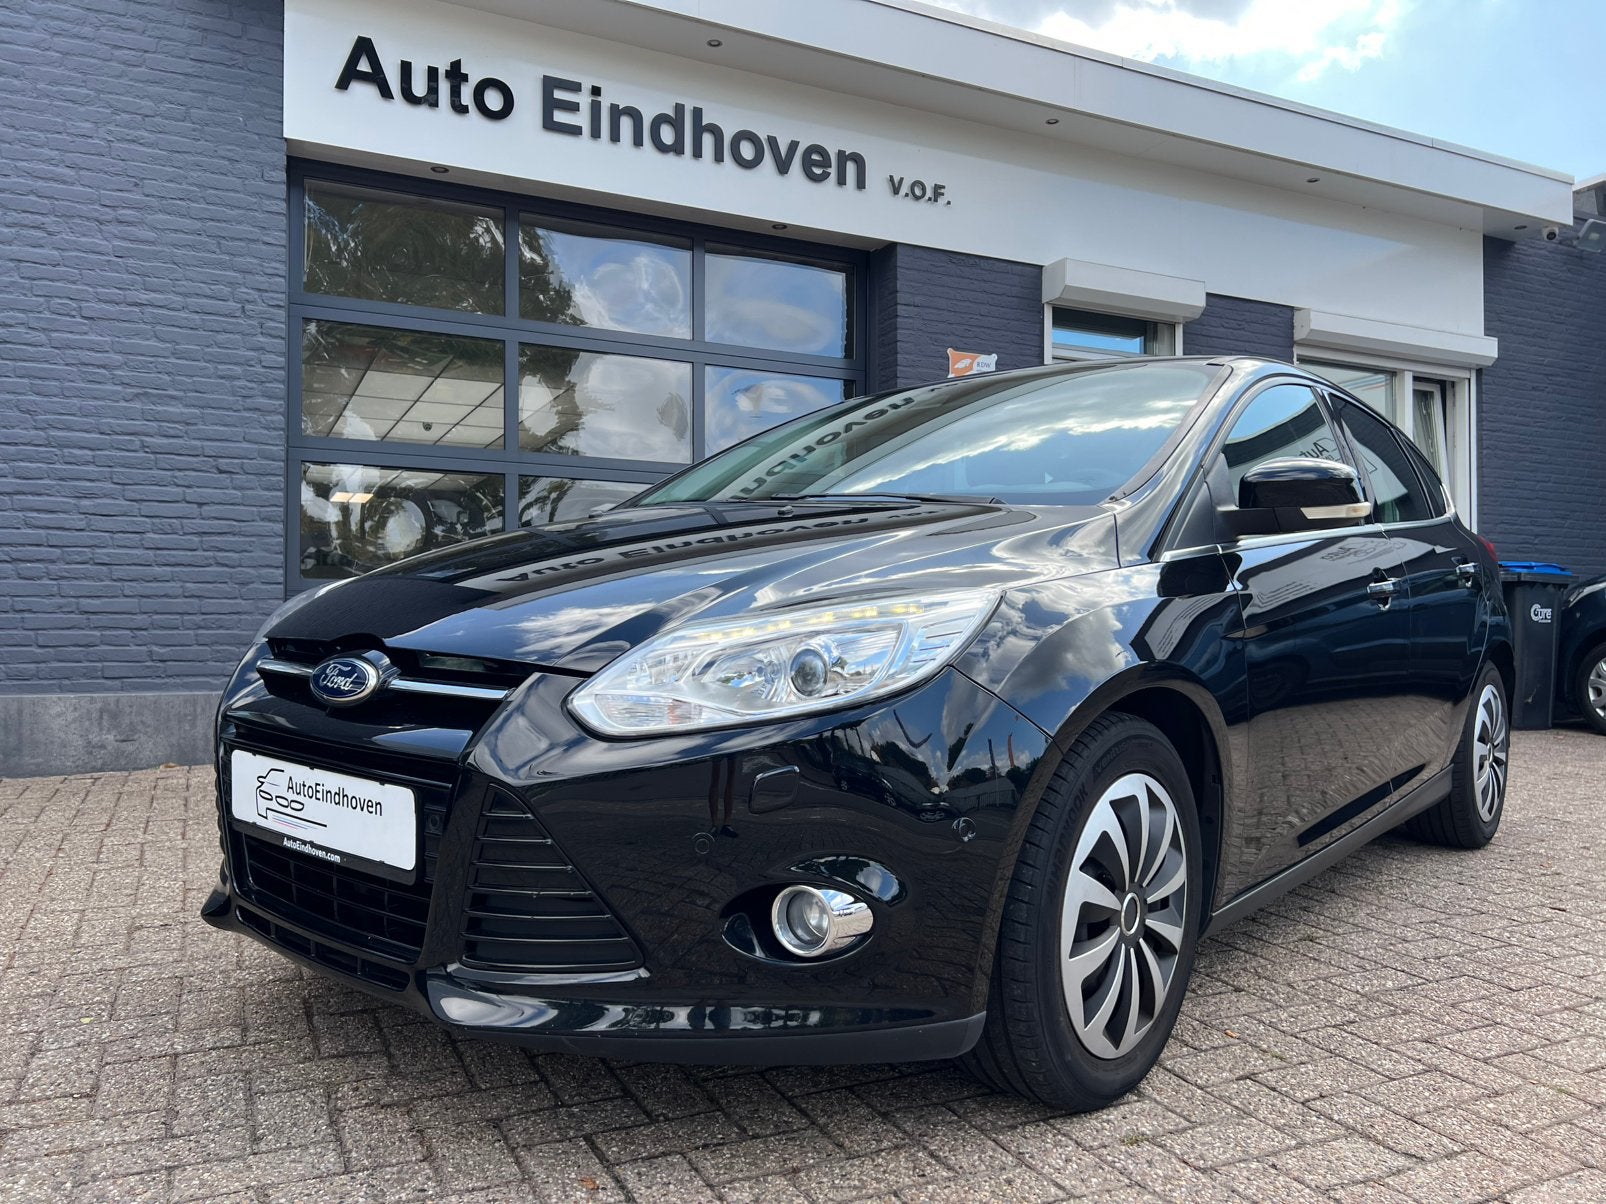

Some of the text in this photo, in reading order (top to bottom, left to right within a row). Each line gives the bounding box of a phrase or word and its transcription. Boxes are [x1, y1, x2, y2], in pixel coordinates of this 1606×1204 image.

[335, 36, 514, 120] Auto
[542, 74, 866, 190] Eindhoven
[1530, 603, 1552, 622] Cure
[319, 663, 356, 691] Ford
[286, 776, 383, 816] AutoEindhoven
[282, 836, 341, 863] AutoEindhoven.com
